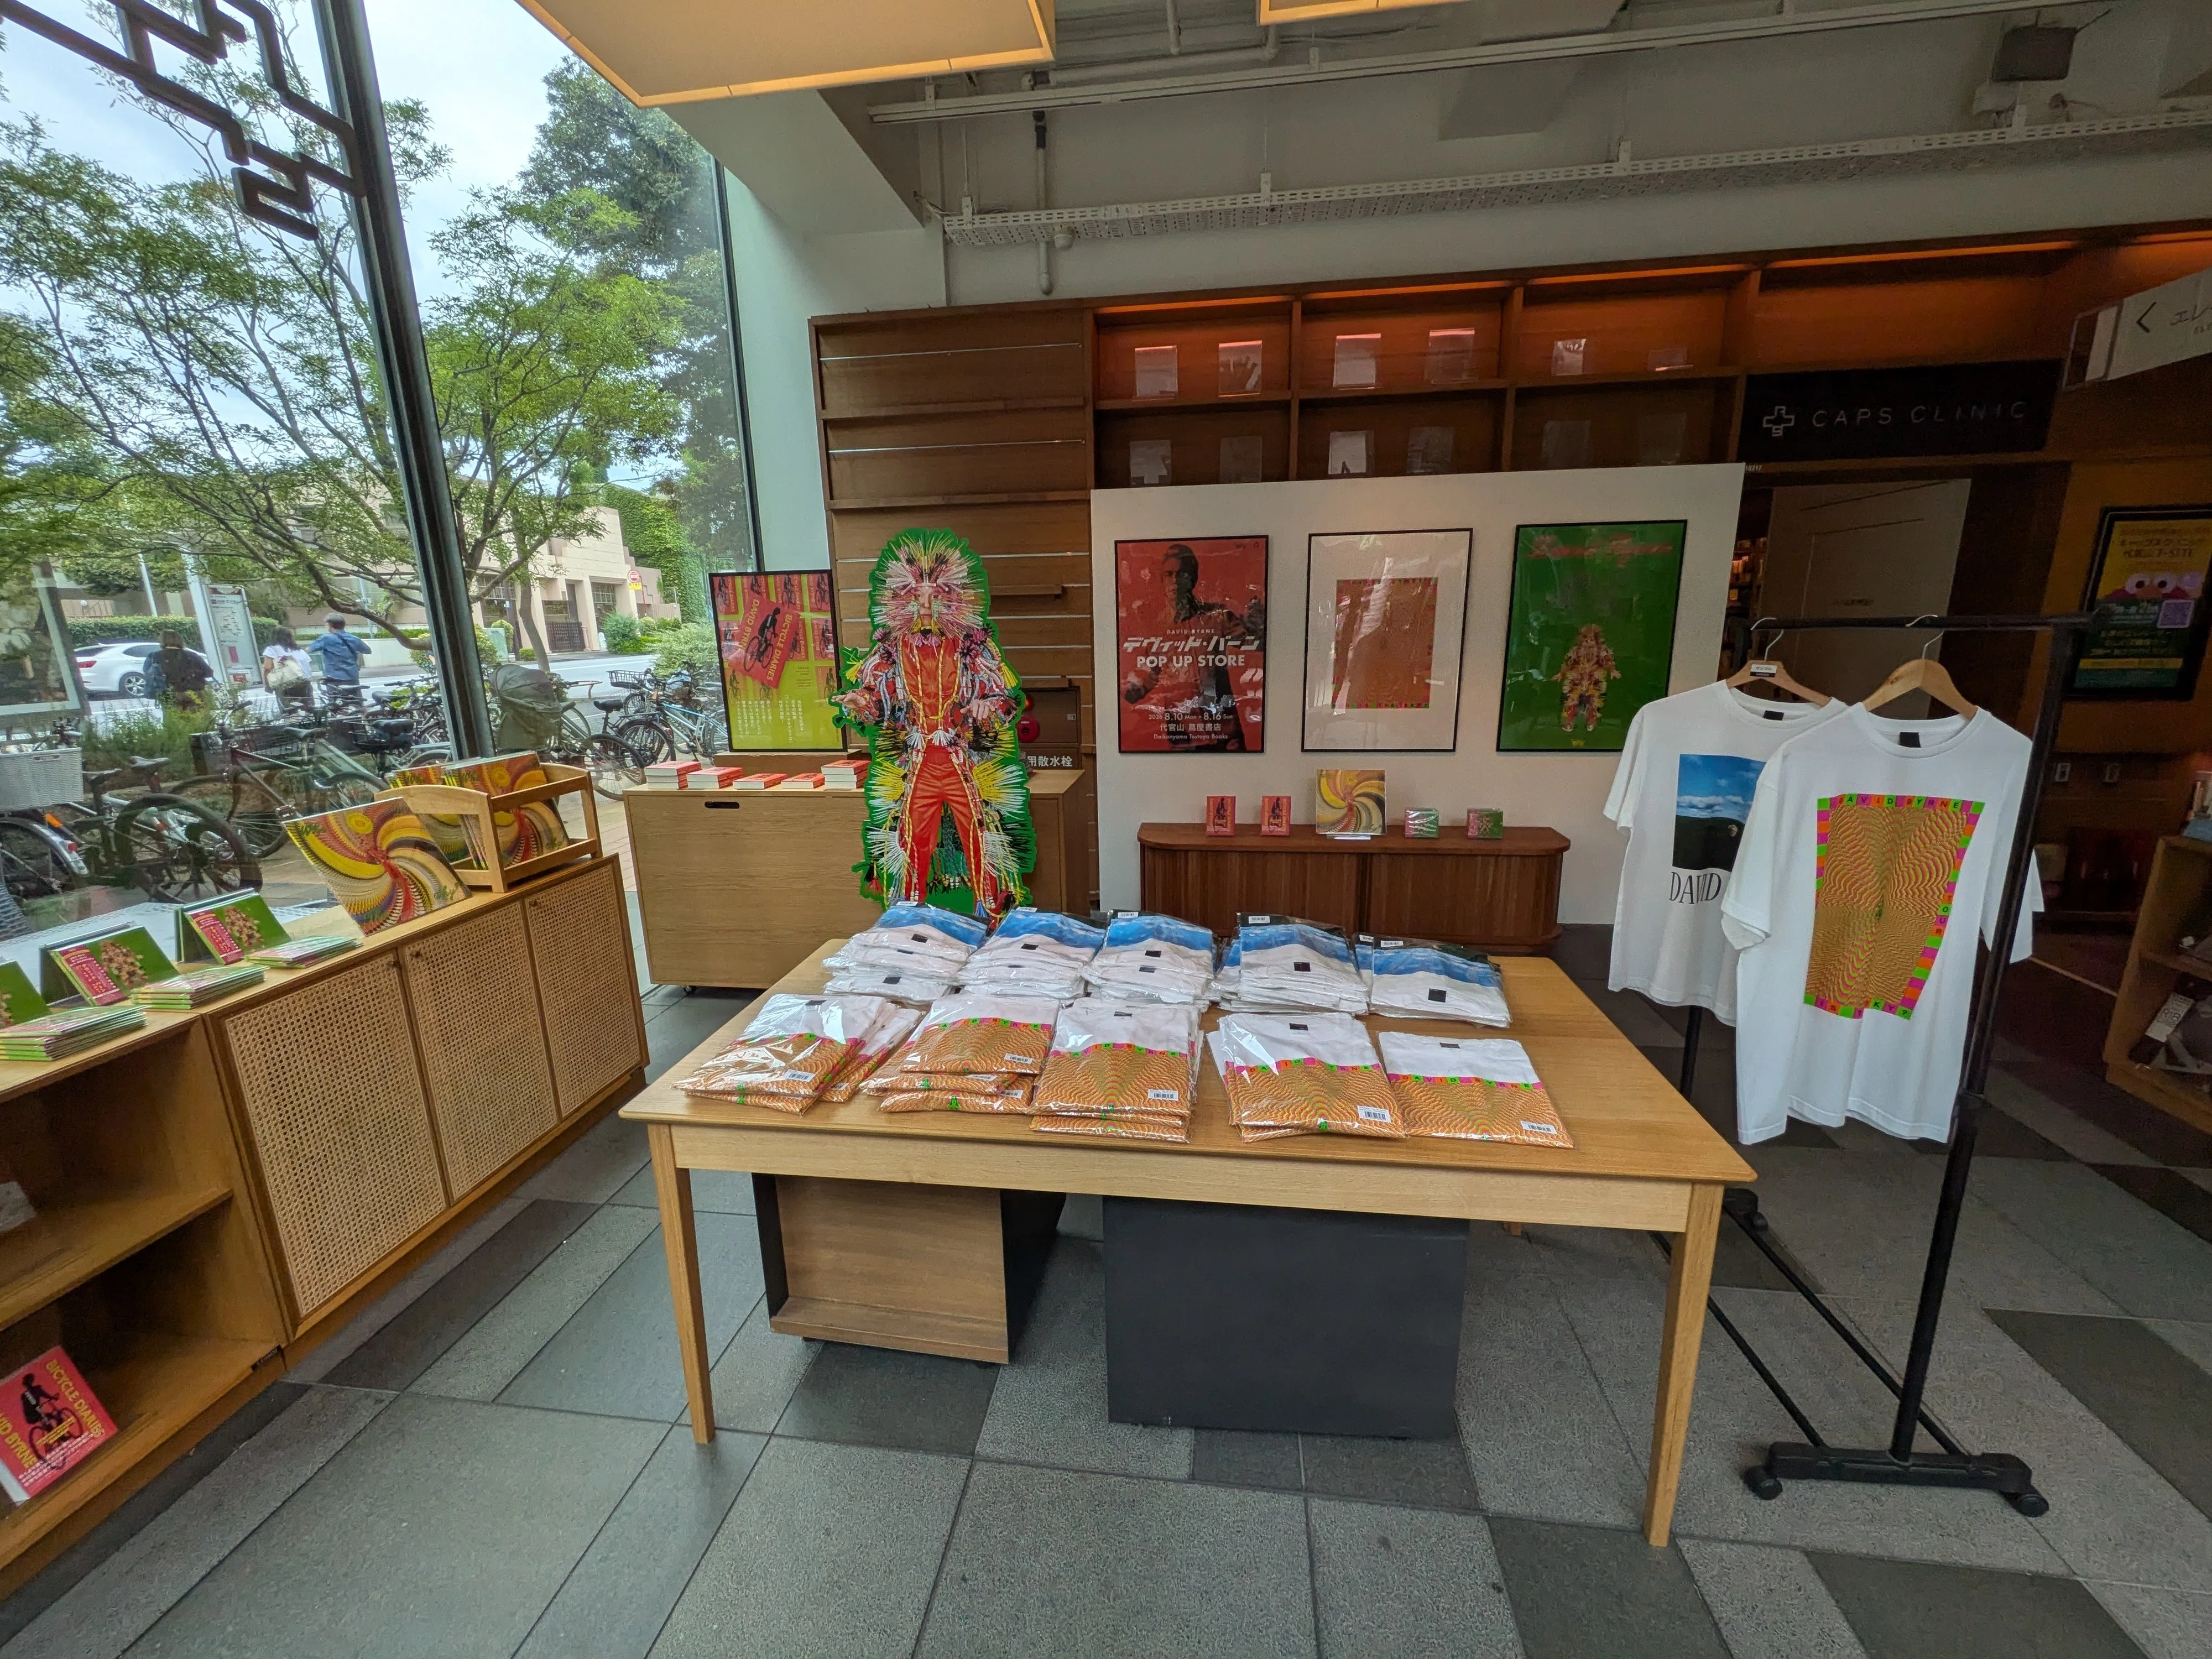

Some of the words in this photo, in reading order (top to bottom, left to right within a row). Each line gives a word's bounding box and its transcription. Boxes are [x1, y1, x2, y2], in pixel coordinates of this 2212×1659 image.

[1812, 407, 1893, 428] CAPS
[1910, 400, 2027, 424] CLINIC
[746, 598, 760, 625] DAVID
[777, 614, 792, 649] BICYCLE
[1123, 635, 1261, 653] デヴィッド・バーン
[766, 647, 782, 681] DIARIES
[1137, 656, 1167, 667] POP
[1172, 655, 1193, 667] UP
[1198, 655, 1245, 667] STORE
[1160, 723, 1185, 732] 代官山
[1165, 713, 1183, 721] 8.10
[1203, 712, 1222, 721] 8.16
[1907, 797, 1959, 809] BYRNE
[1668, 871, 1721, 905] DAVID
[992, 1018, 1039, 1029] BYRNE
[1474, 1078, 1530, 1089] BYRNE
[45, 1359, 80, 1402] BICYCLE
[73, 1397, 106, 1438] DIARIES
[4, 1432, 38, 1469] BYRNE
